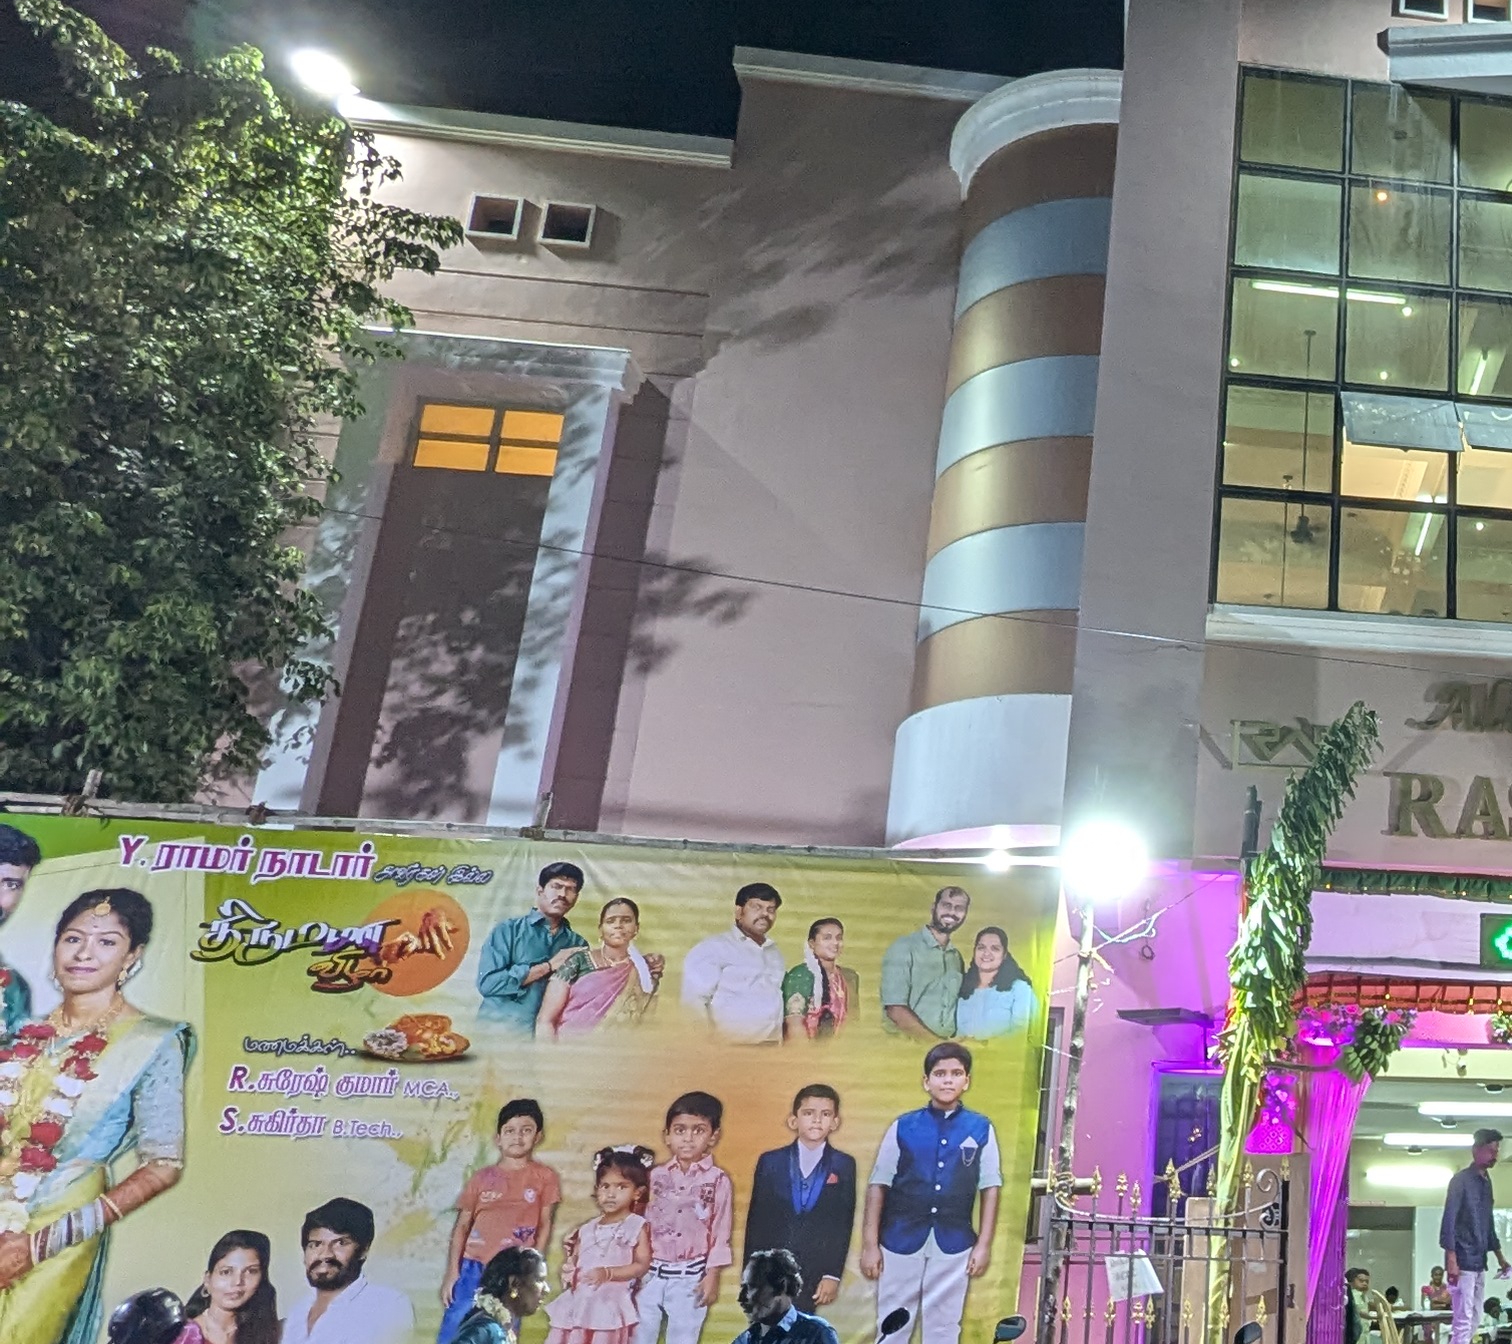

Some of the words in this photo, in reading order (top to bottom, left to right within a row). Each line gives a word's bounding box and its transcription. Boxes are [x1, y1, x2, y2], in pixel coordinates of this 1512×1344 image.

[119, 835, 146, 867] Y.
[150, 835, 254, 872] ராமர்
[252, 840, 377, 884] நாடார்
[190, 899, 400, 962] திருமண
[307, 949, 393, 993] விழா
[335, 1068, 399, 1098] குமார்
